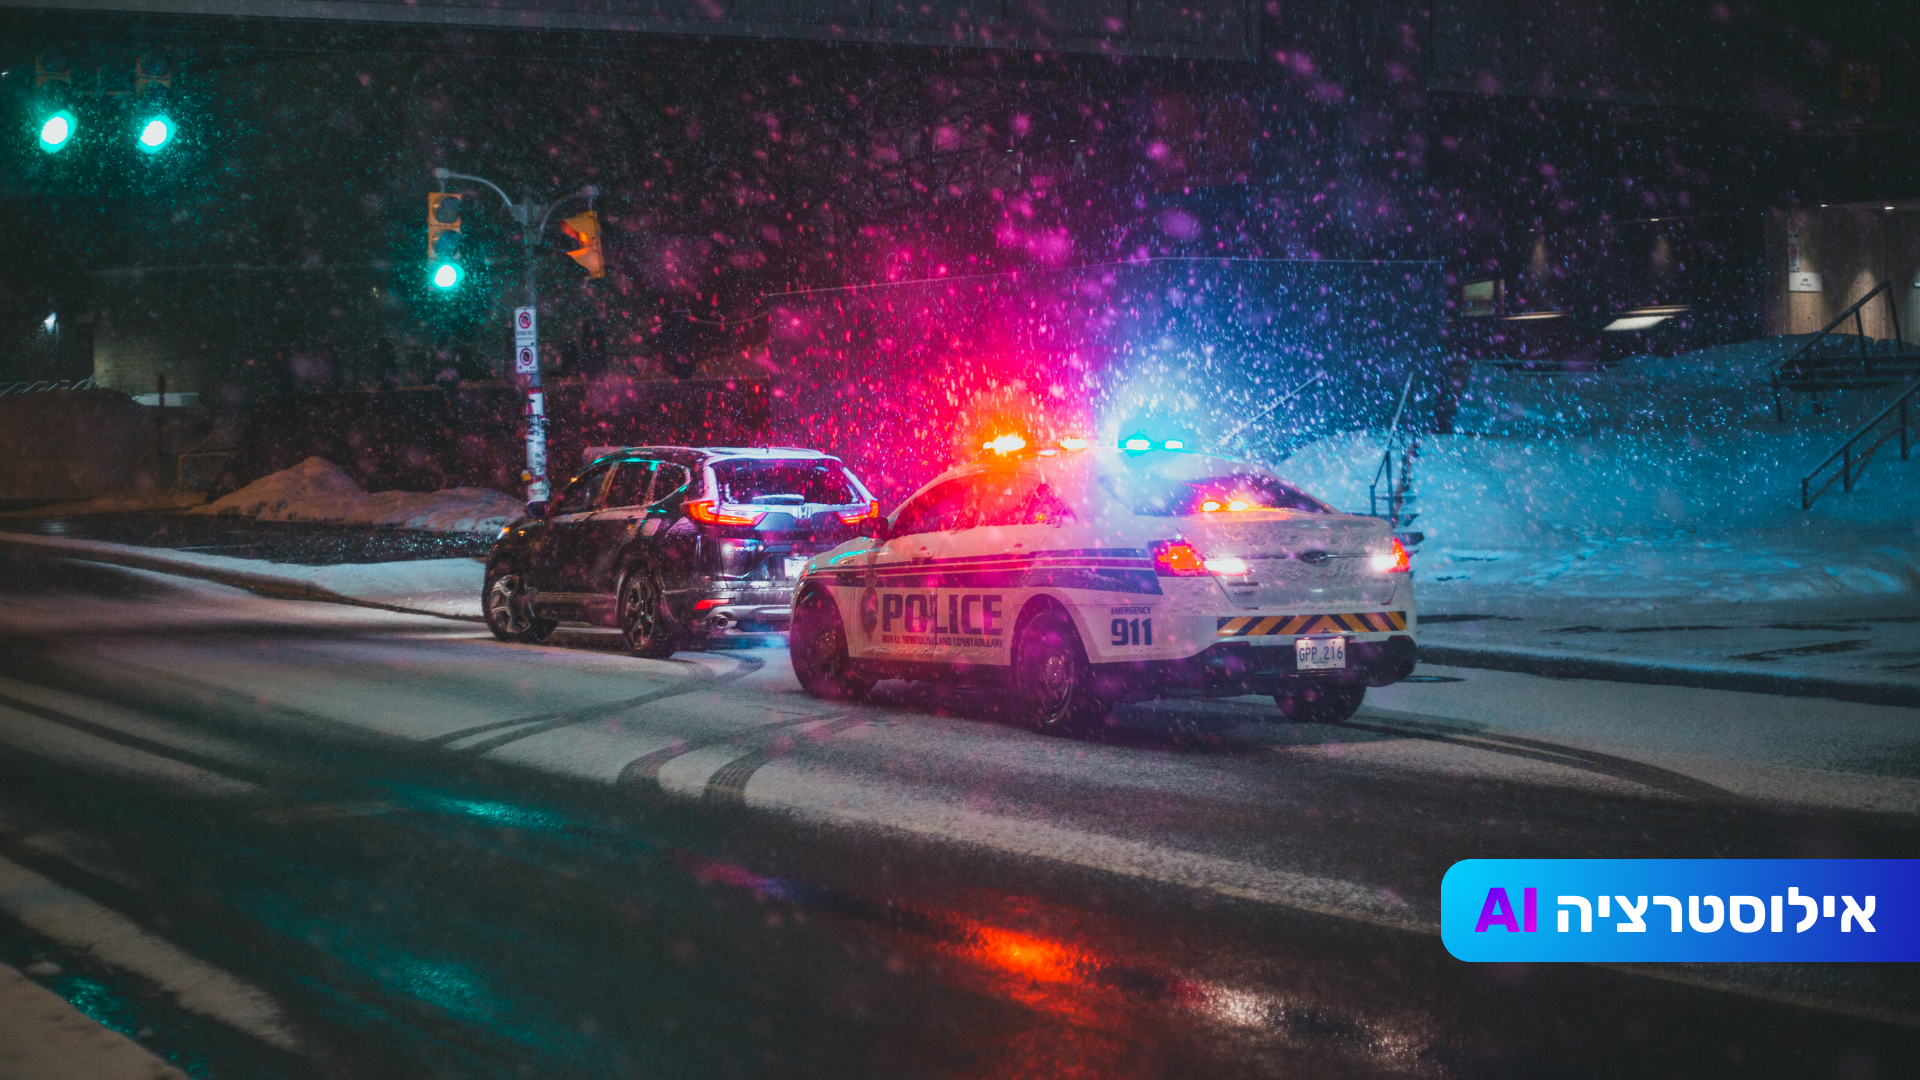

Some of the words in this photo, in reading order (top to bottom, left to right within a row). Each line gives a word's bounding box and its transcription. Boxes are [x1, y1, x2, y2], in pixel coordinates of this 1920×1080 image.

[883, 594, 1003, 635] POLICE
[1111, 606, 1152, 615] EMERGENCY
[1111, 618, 1152, 646] 911
[881, 634, 901, 644] ROYAL
[953, 637, 1004, 648] CONSTABULARY
[1299, 646, 1317, 661] GPP
[1324, 645, 1343, 660] 216
